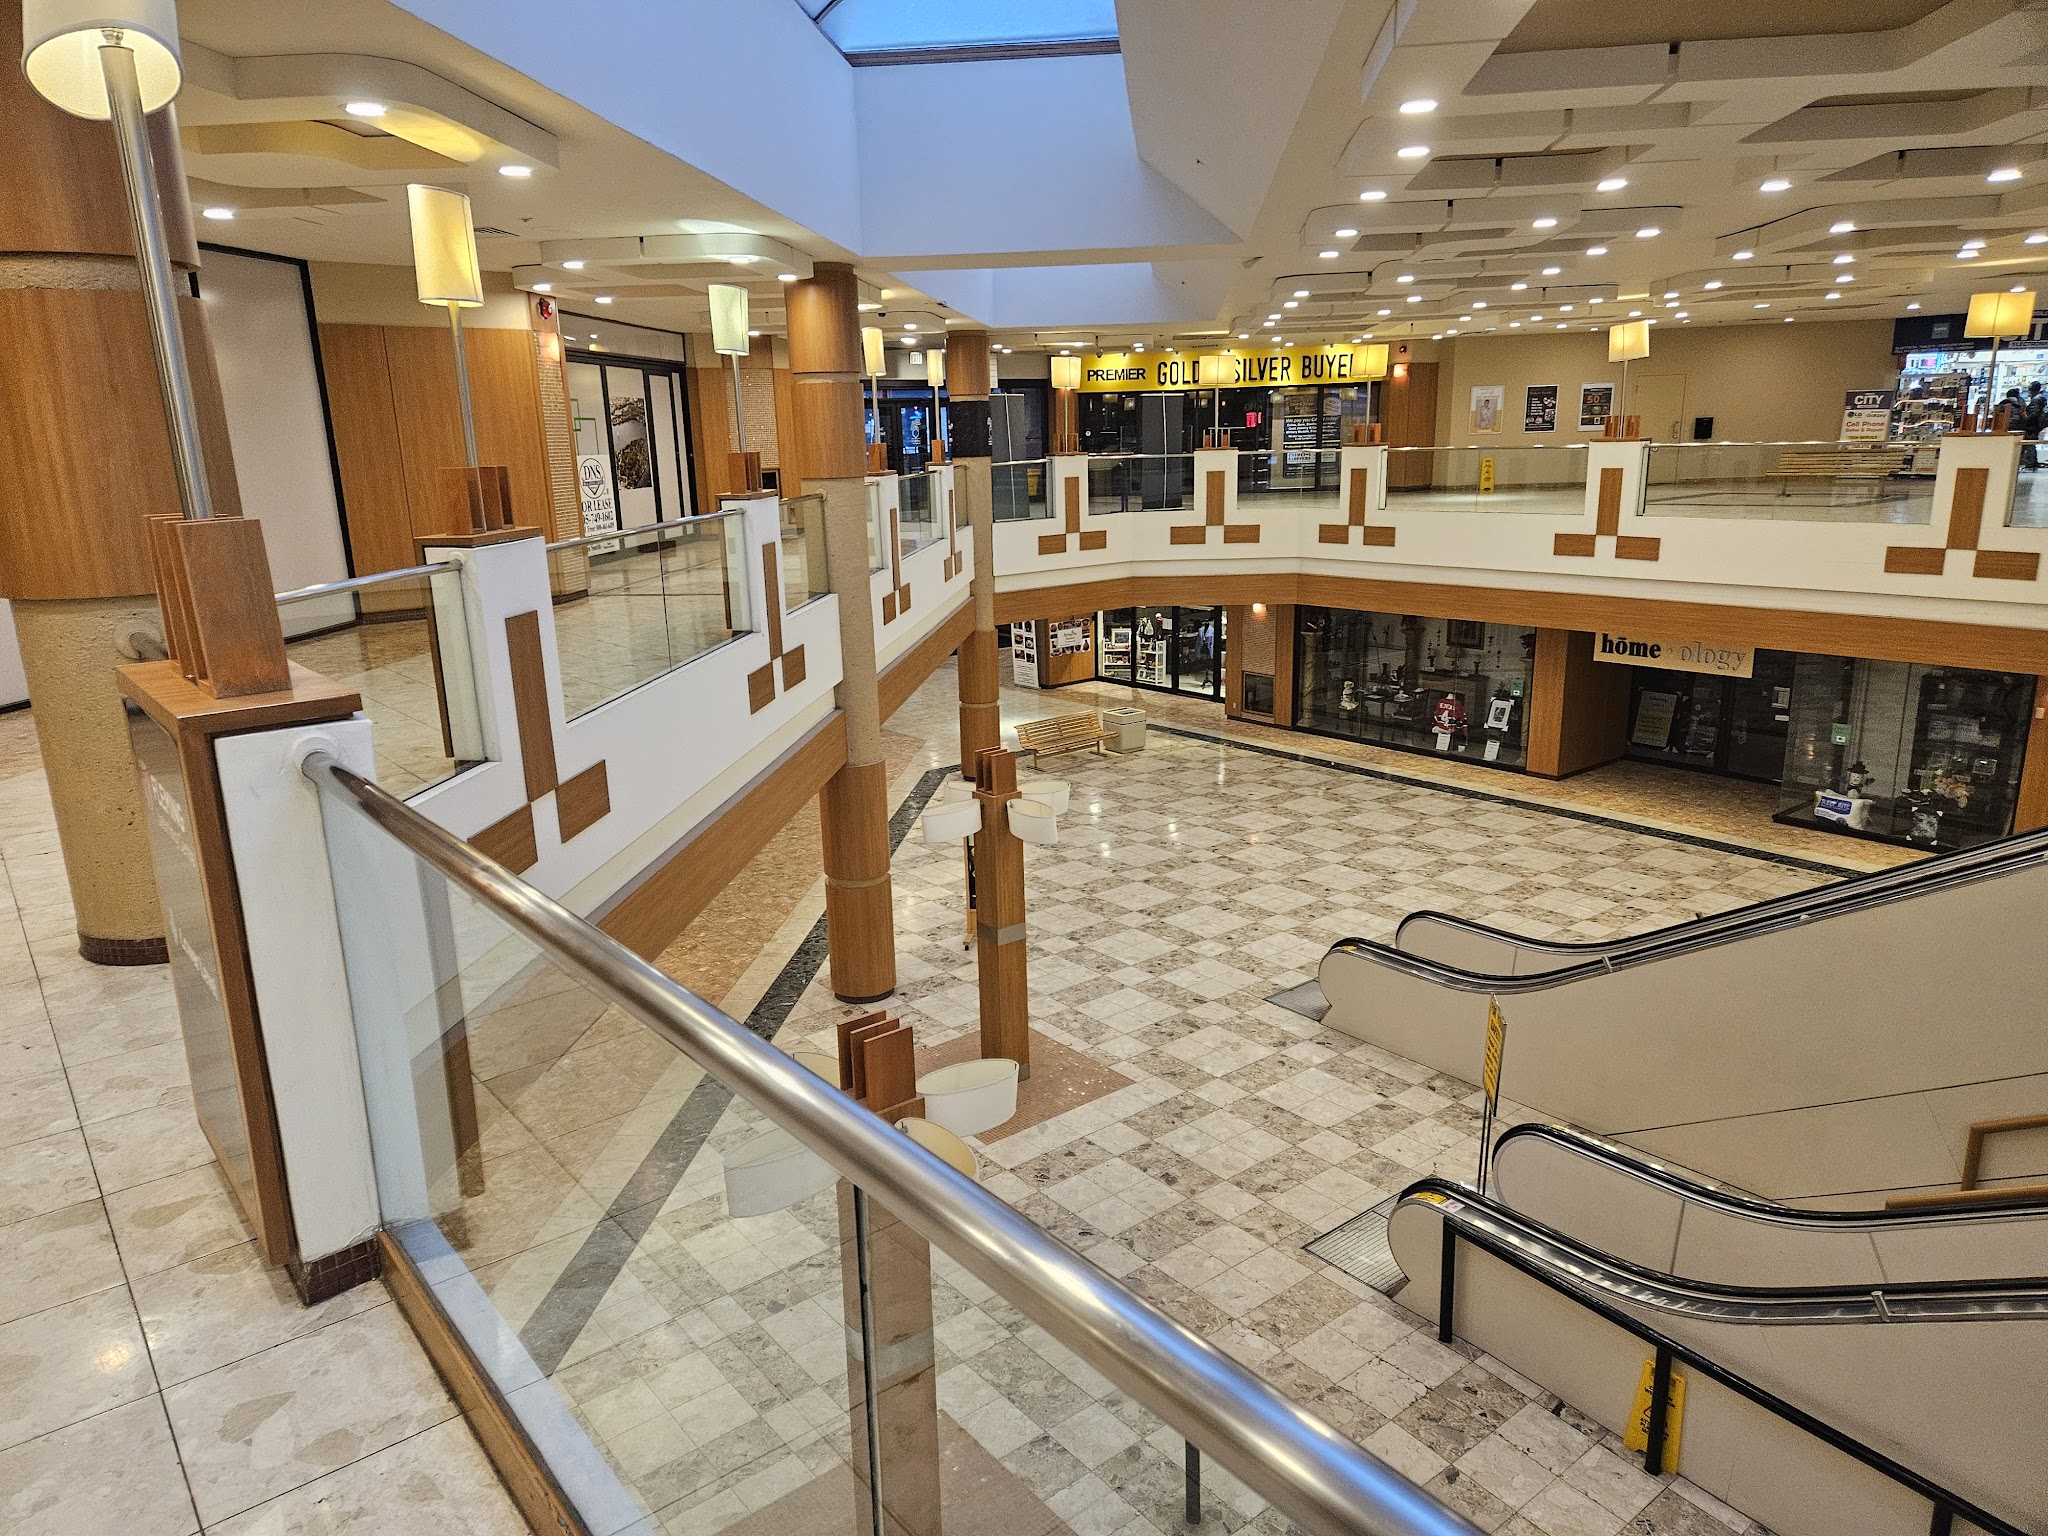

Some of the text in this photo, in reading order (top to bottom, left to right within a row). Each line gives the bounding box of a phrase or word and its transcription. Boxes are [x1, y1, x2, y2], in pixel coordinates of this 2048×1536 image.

[1087, 354, 1353, 386] PREMIER GOLD SILVER BUYE
[1587, 395, 1600, 404] 50
[1854, 395, 1884, 405] CITY
[583, 465, 602, 480] DNS
[582, 498, 612, 512] OR LEASE
